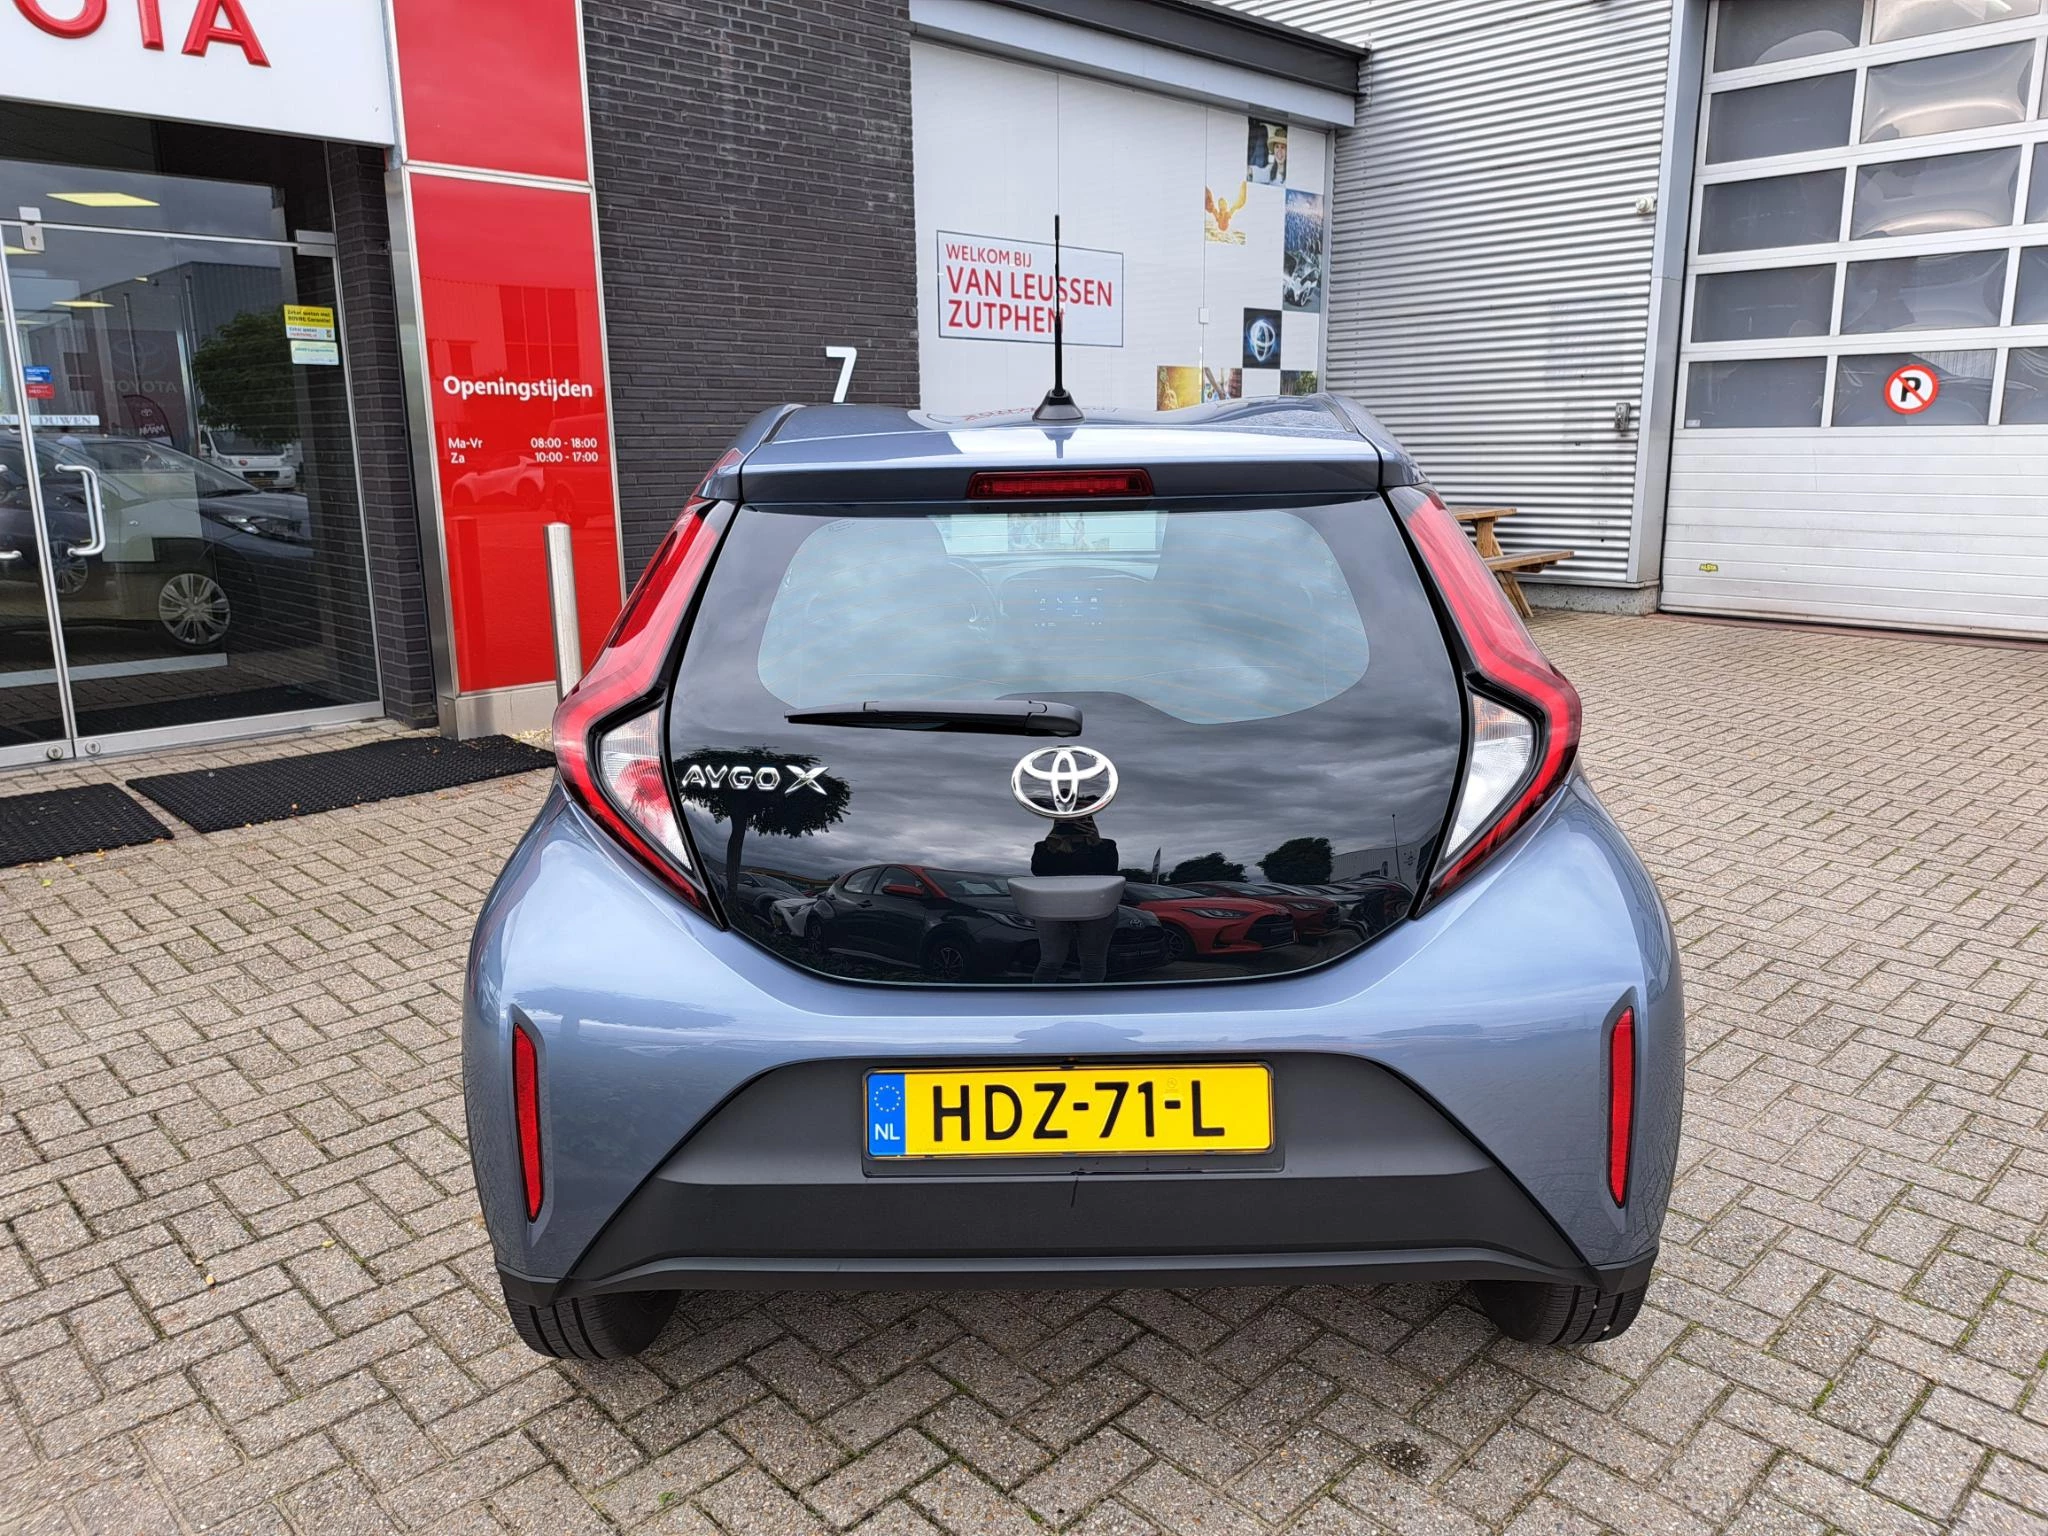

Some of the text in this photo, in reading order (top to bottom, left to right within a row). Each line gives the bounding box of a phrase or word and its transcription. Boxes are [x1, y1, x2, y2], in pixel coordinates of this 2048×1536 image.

[946, 243, 1032, 268] WELKOM BIJ
[947, 265, 1112, 307] VAN LEUSSEN
[948, 299, 1064, 334] ZUTPHEN
[825, 345, 858, 403] 7
[443, 375, 593, 401] Openingstijden
[1900, 377, 1922, 402] P
[448, 437, 483, 449] Ma-Vr
[530, 437, 562, 448] 08:00
[570, 437, 598, 448] 18:00
[451, 452, 465, 464] Za
[535, 451, 563, 463] 10:00
[572, 451, 599, 463] 17:00
[682, 764, 830, 796] AYGO X
[933, 1080, 1225, 1142] HDZ-71-L
[874, 1123, 900, 1141] NL
